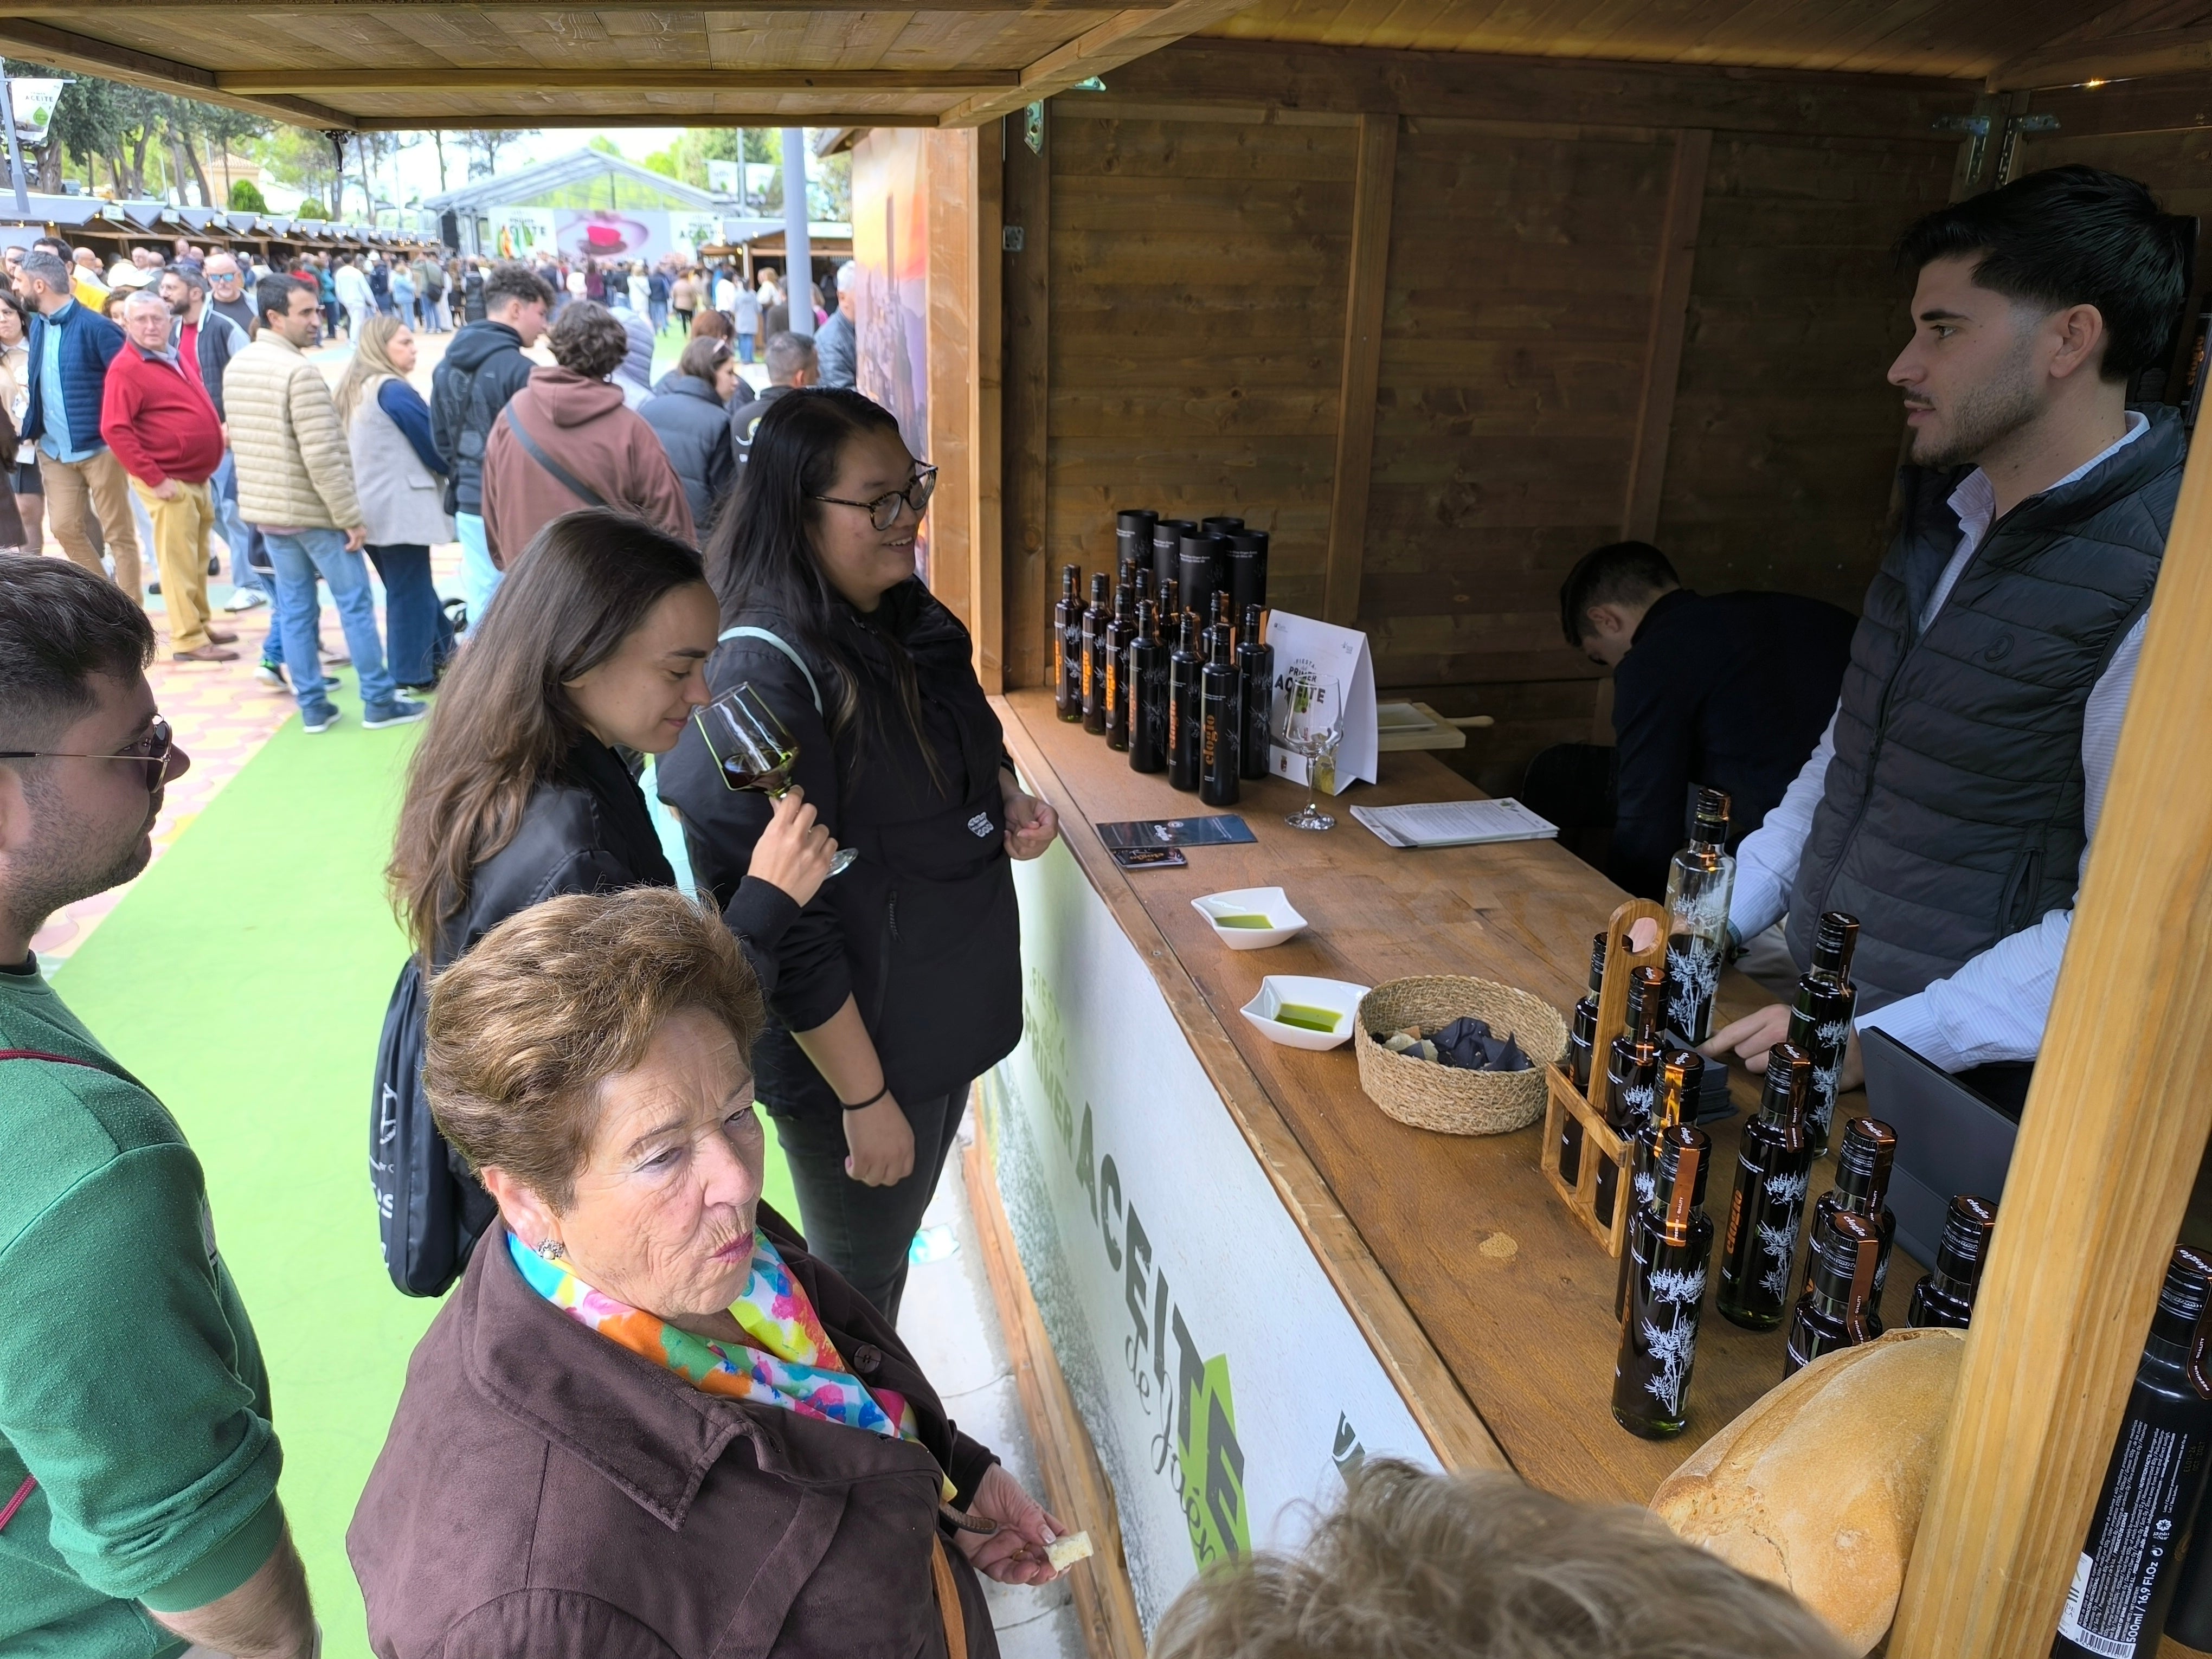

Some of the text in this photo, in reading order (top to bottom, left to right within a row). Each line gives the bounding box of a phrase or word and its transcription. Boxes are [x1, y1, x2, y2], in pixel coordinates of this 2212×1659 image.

[1296, 658, 1315, 668] FIESTA
[1203, 714, 1219, 766] elogio
[1025, 998, 1073, 1160] PRIMER
[1726, 1189, 1743, 1255] elogio
[1843, 1216, 1866, 1237] elogio
[1076, 1100, 1245, 1564] ACEITE
[2194, 1338, 2210, 1391] PREMIUM QUALITY
[1125, 1333, 1217, 1564] de Jaén
[2113, 1533, 2123, 1553] PRODUCTO
[2120, 1512, 2129, 1528] ESPAÑA
[2125, 1559, 2158, 1643] 500ml 16,9 Fl.Oz
